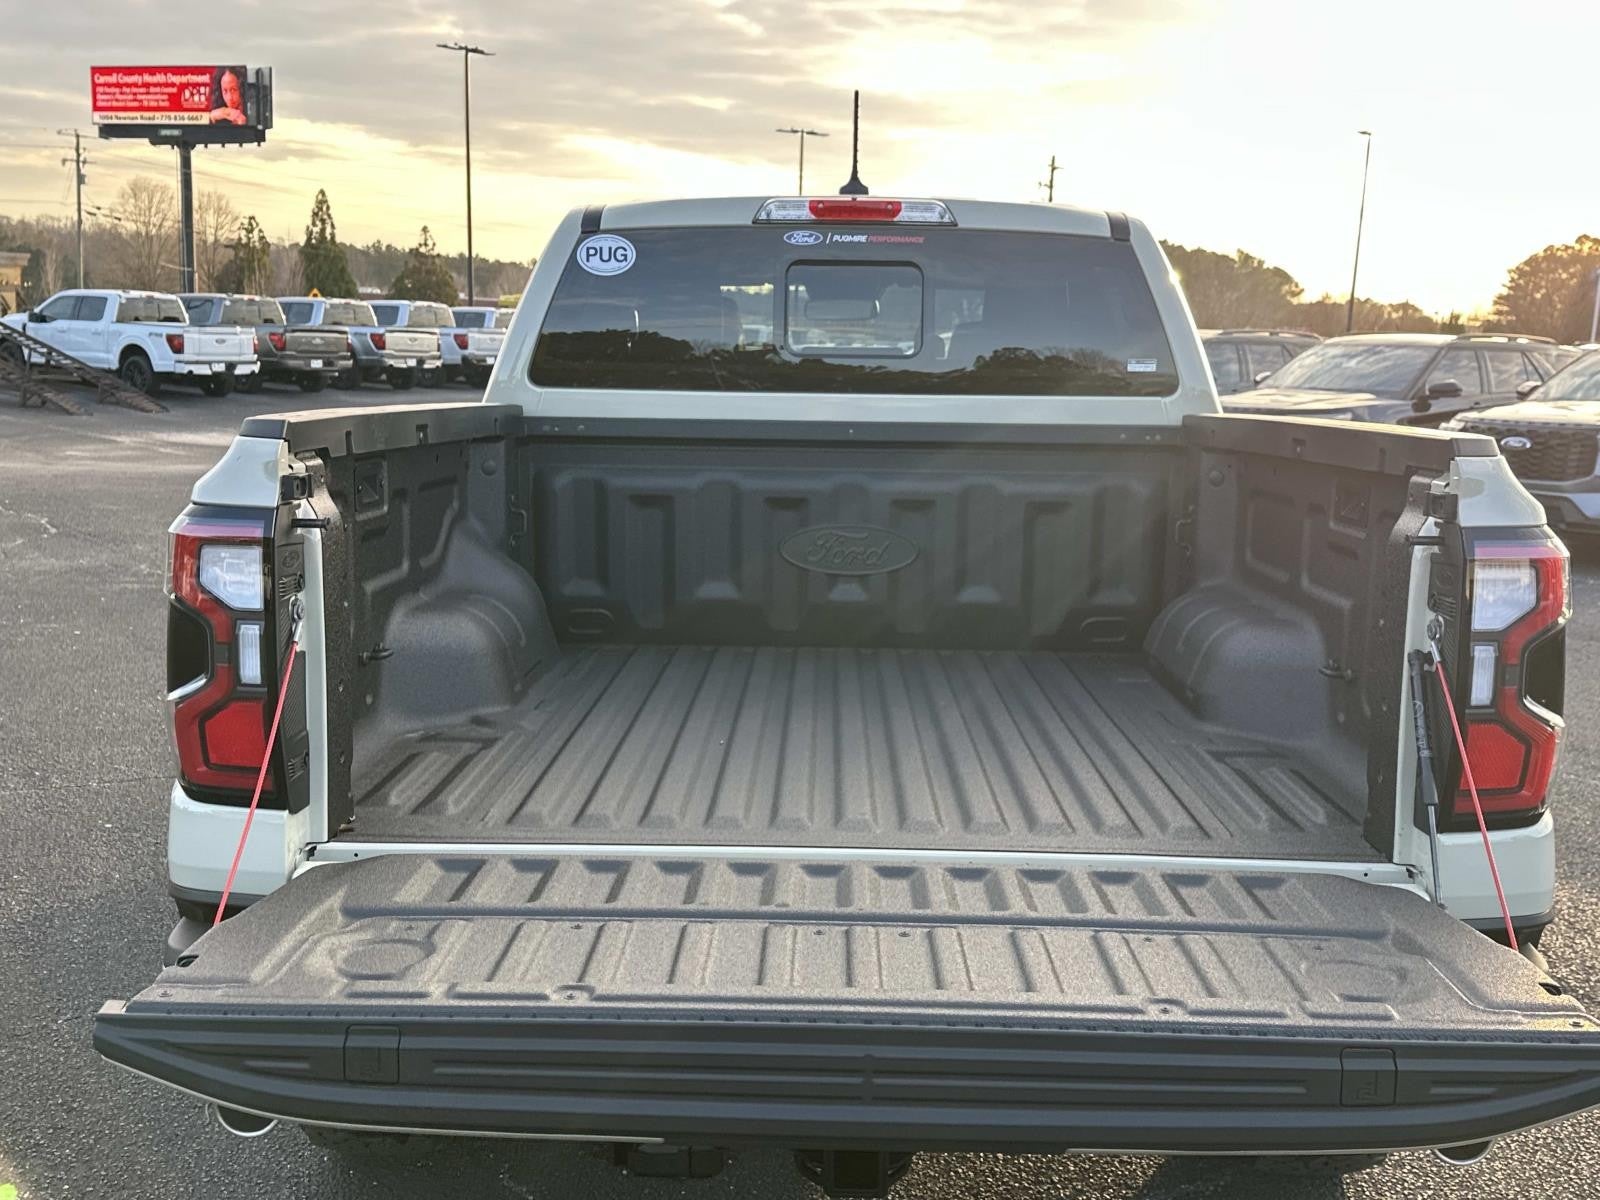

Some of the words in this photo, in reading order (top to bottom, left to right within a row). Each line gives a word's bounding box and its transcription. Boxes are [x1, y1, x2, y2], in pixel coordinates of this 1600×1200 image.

[118, 73, 142, 86] County
[143, 72, 166, 84] Health
[167, 72, 210, 86] Department
[140, 113, 156, 121] Road
[832, 234, 868, 243] PUGMIRE
[868, 235, 925, 244] PERFORMANCE
[586, 246, 628, 263] PUG
[807, 530, 893, 566] Ford
